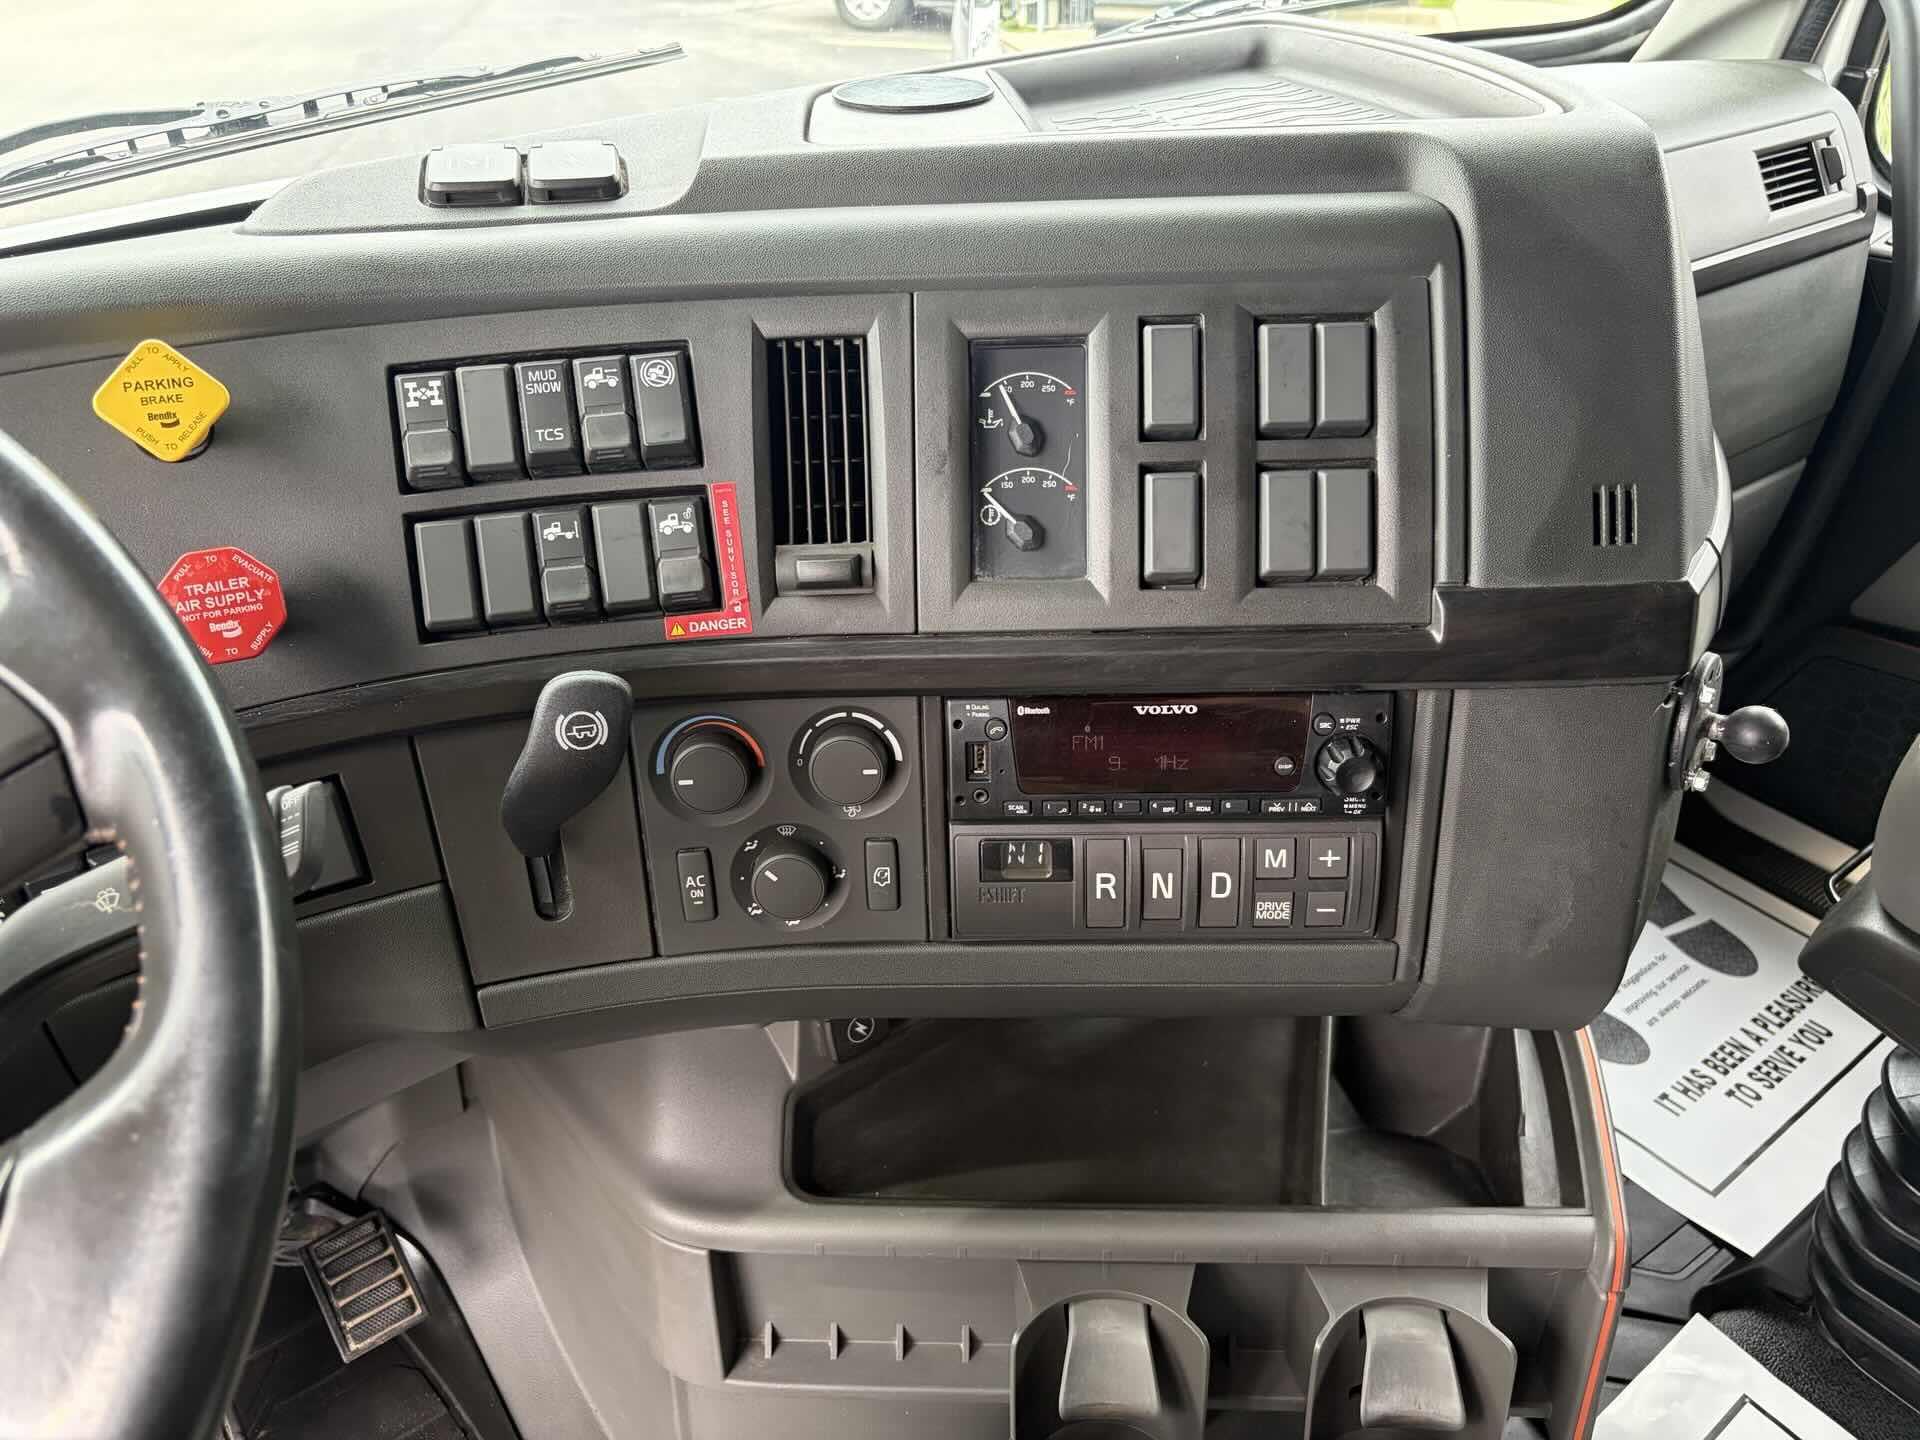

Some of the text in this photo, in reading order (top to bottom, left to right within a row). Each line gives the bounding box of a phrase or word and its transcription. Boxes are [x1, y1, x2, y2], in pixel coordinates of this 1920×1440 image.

[126, 346, 190, 374] PULL TO APPLY
[528, 369, 557, 382] MUD
[123, 376, 195, 393] PARKING
[525, 381, 561, 395] SNOW
[1020, 380, 1035, 389] 200
[141, 394, 184, 407] BRAKE
[148, 411, 177, 421] Bendix
[135, 411, 208, 451] PUSH TO RELEASE
[535, 427, 565, 442] TCS
[1021, 476, 1036, 484] 200
[1042, 480, 1057, 488] 250
[721, 500, 731, 525] SEE
[173, 554, 275, 583] PULL TO EVACUATE
[184, 576, 250, 597] TRAILER
[175, 588, 265, 614] AIR SUPPLY
[182, 603, 263, 623] NOT FOR PARKING
[208, 620, 240, 633] Bendix
[688, 617, 747, 633] DANGER
[226, 647, 239, 656] TO
[250, 621, 274, 651] SUPPLY
[1132, 704, 1199, 716] VOLVO
[1264, 849, 1287, 868] M
[685, 874, 706, 888] AC
[1095, 872, 1117, 899] R
[1151, 872, 1174, 899] N
[1210, 872, 1232, 898] D
[690, 888, 704, 898] ON
[1256, 901, 1291, 911] DRIVE
[1256, 910, 1290, 920] MODE
[1653, 973, 1827, 1117] IT HAS BEEN A PLEASUR
[1724, 1018, 1834, 1109] TO SERVE YOU
